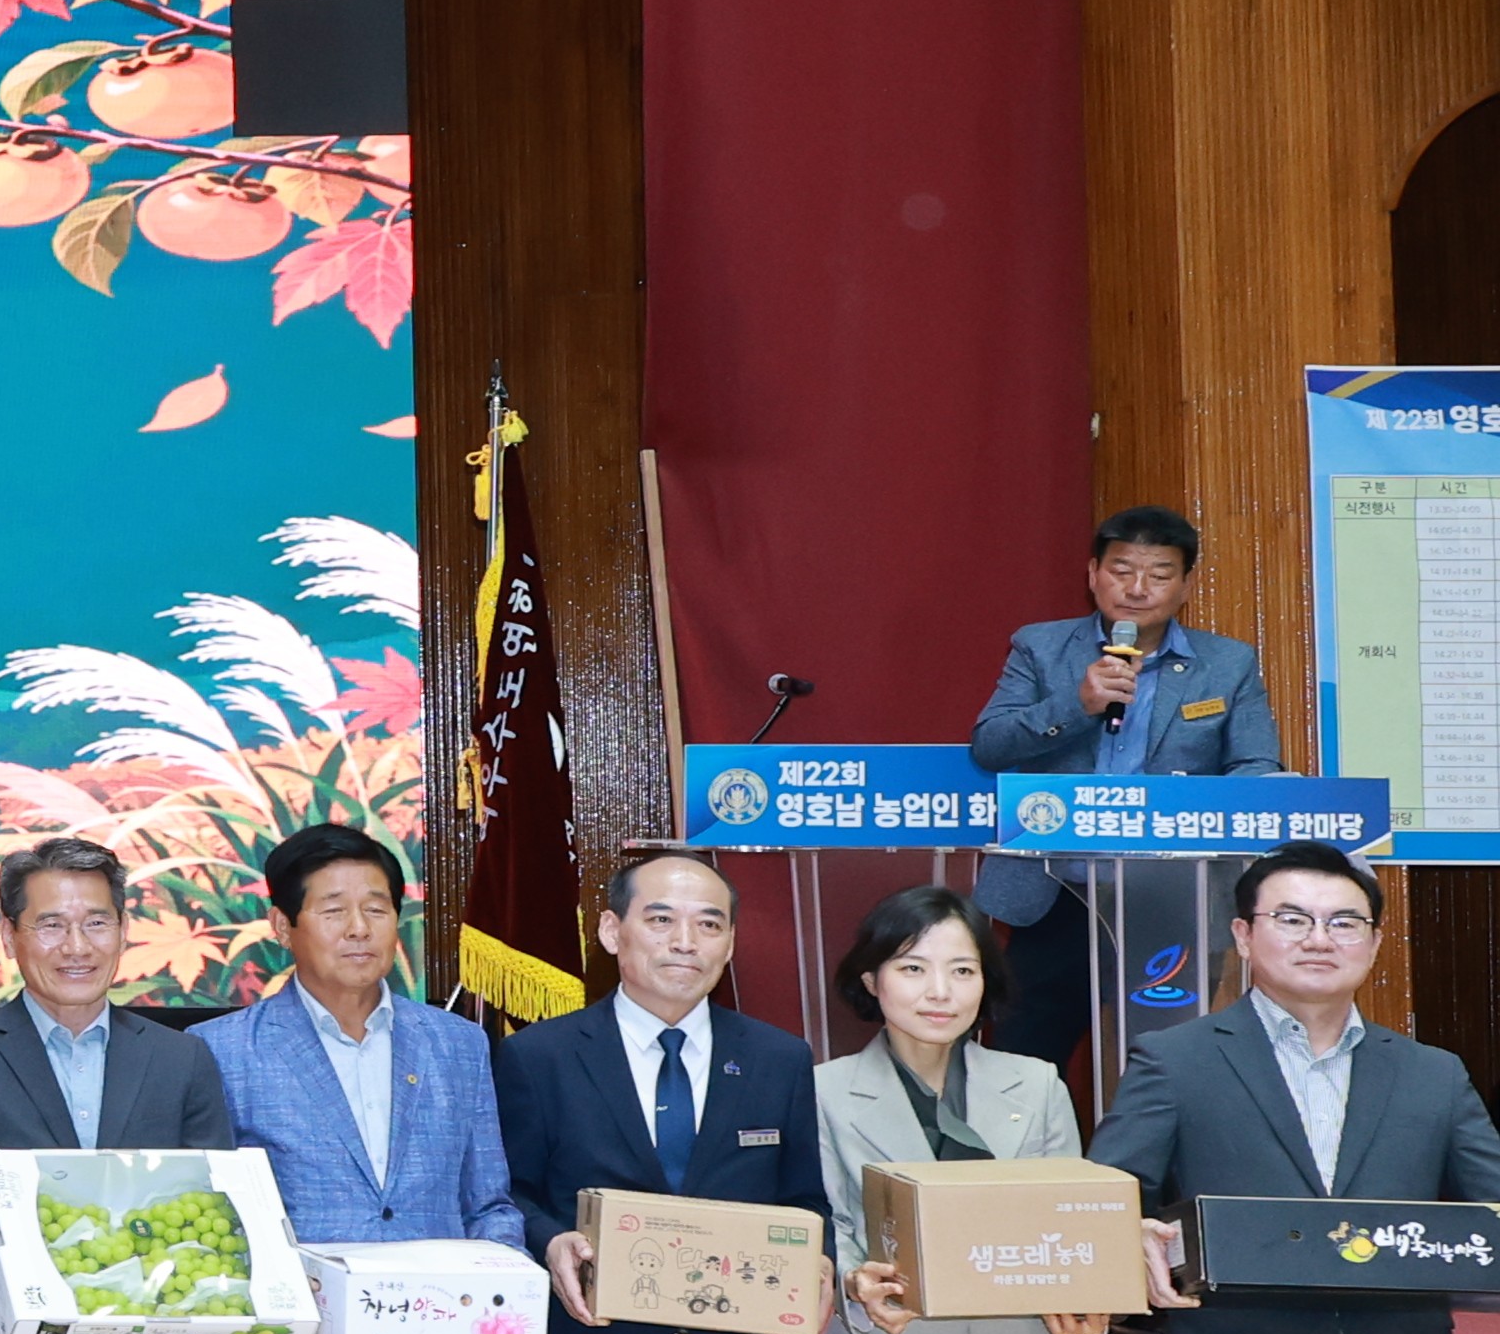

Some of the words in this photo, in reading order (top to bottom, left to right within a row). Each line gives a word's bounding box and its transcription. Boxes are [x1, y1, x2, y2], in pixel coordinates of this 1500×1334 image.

[1344, 500, 1396, 516] 식전행사
[1358, 645, 1398, 659] 개회식
[777, 760, 866, 788] 제22회
[1073, 786, 1146, 808] 제22회
[776, 792, 864, 829] 영호남
[873, 793, 960, 829] 농업인
[1072, 810, 1145, 839] 영호남
[1151, 811, 1225, 840] 농업인
[1231, 813, 1282, 841] 화합
[1288, 813, 1364, 842] 한마당
